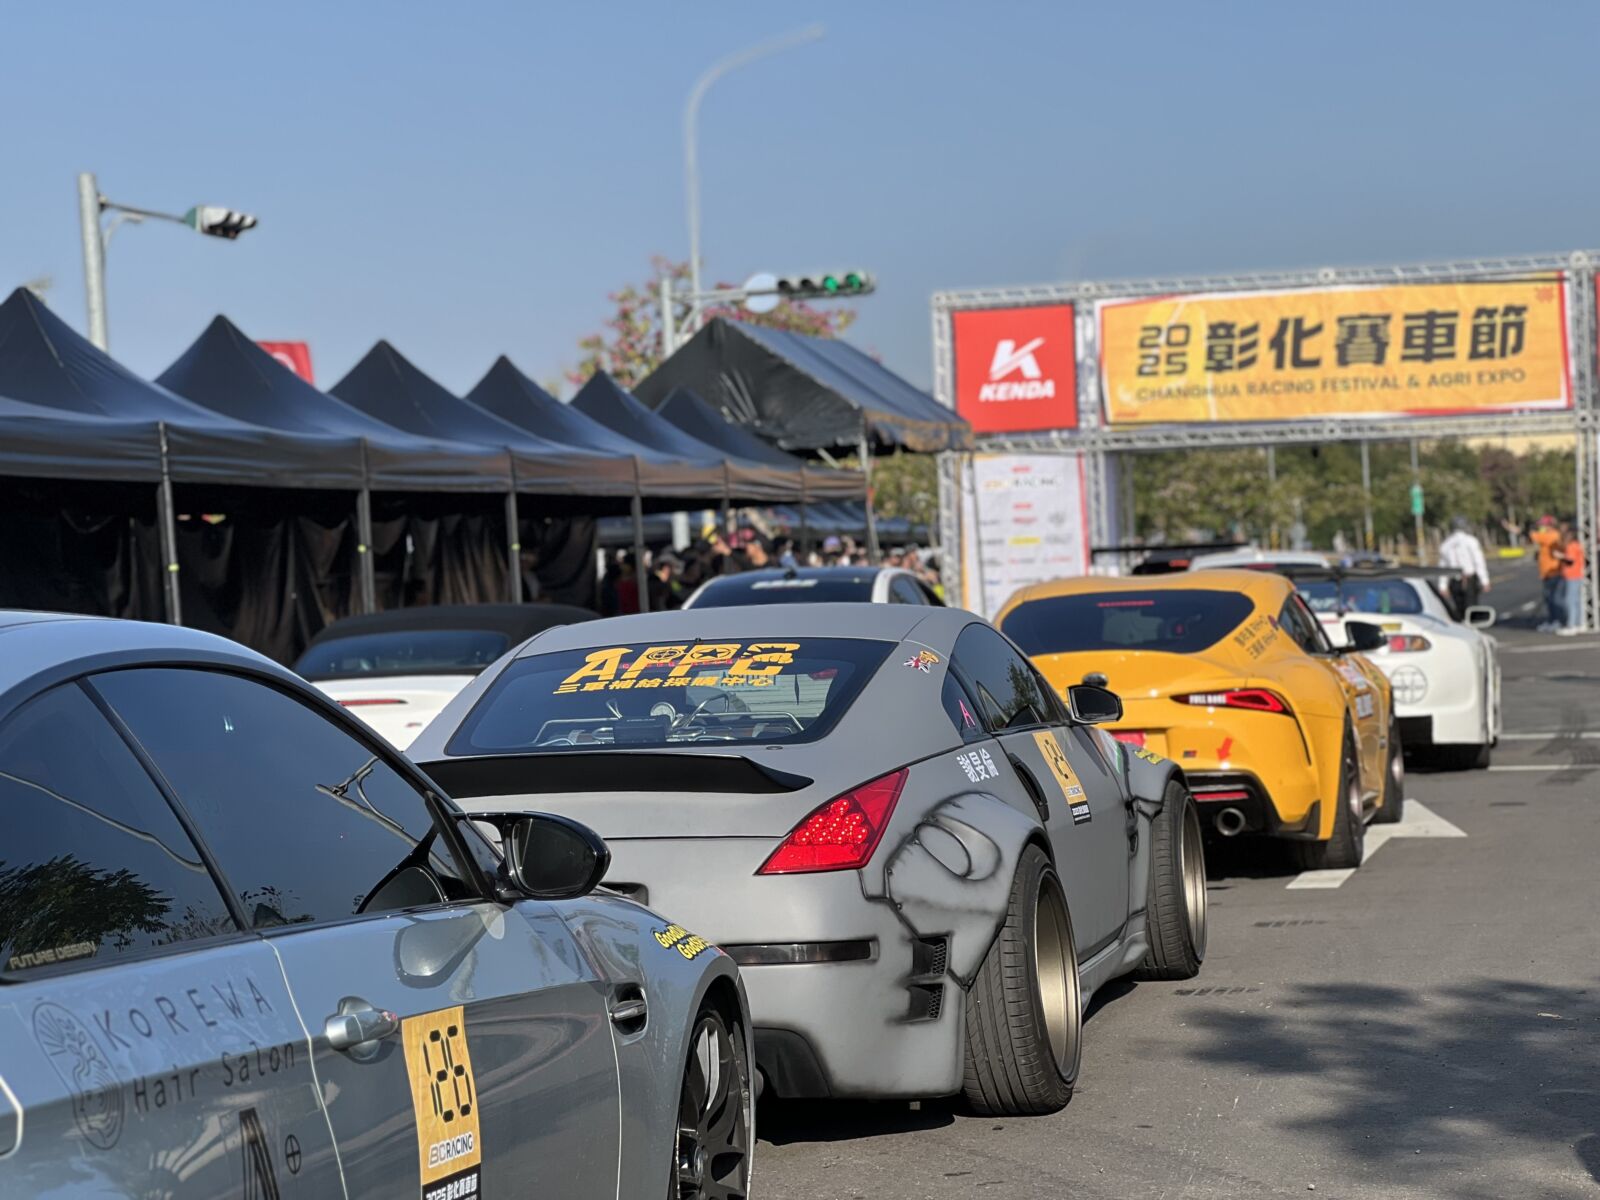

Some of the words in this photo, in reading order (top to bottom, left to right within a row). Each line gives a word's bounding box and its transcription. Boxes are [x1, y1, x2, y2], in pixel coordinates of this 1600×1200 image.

[1204, 305, 1528, 372] 彰化賽車節
[979, 379, 1055, 402] KENDA
[1136, 380, 1240, 401] CHANGHUA
[1246, 379, 1315, 396] RACING
[1321, 374, 1399, 393] FESTIVAL
[1407, 374, 1420, 388] &
[1427, 371, 1472, 388] AGRI
[1477, 367, 1526, 384] EXPO
[10, 949, 56, 969] FUTURE
[55, 941, 96, 960] DESIGN
[93, 978, 273, 1051] KOREWA
[134, 1064, 200, 1113] Hair
[221, 1041, 295, 1087] Salon
